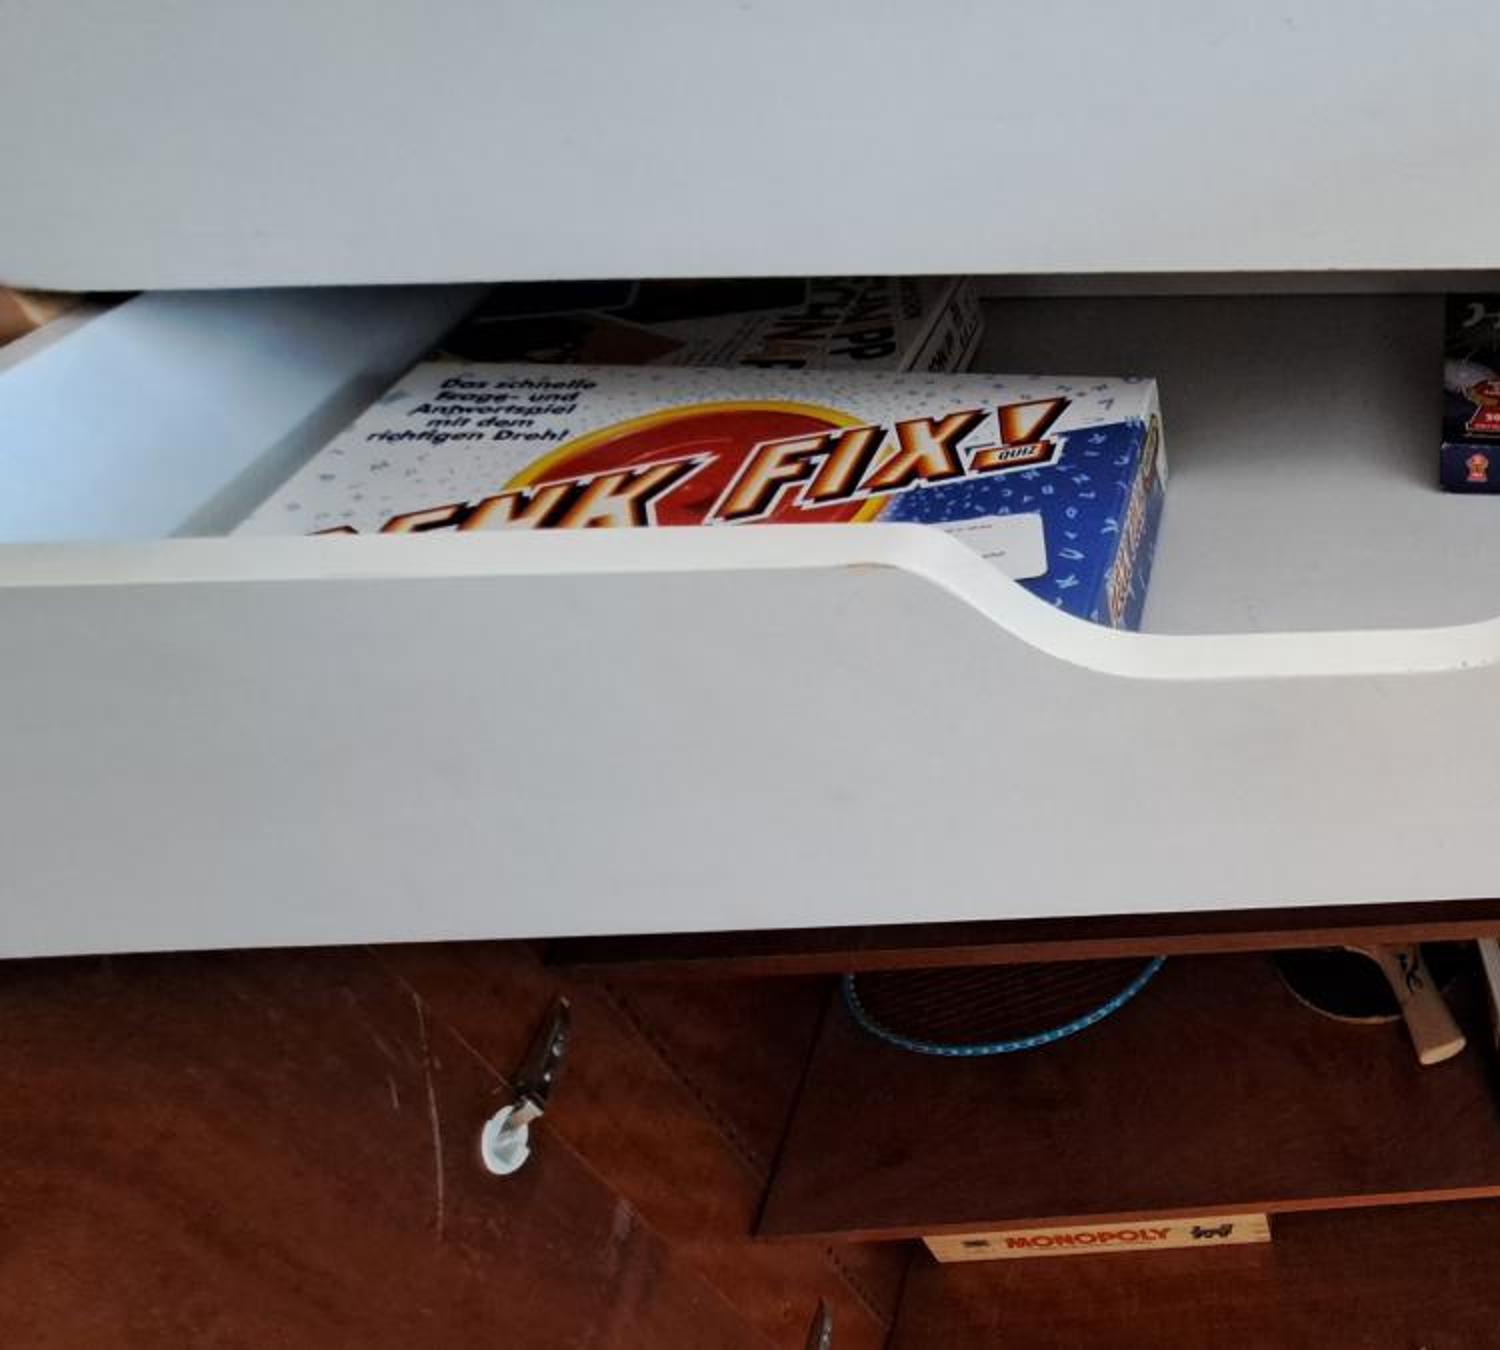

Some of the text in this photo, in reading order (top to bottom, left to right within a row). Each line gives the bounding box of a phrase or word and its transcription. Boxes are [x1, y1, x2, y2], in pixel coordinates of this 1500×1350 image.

[440, 378, 598, 390] Das schnelle
[529, 391, 580, 402] und
[408, 403, 577, 416] Antwortspiel
[425, 417, 534, 428] mit dem
[366, 430, 571, 445] richtigen Dreh!
[714, 396, 1069, 520] FIX!
[1005, 1228, 1169, 1248] MONOPOLY
